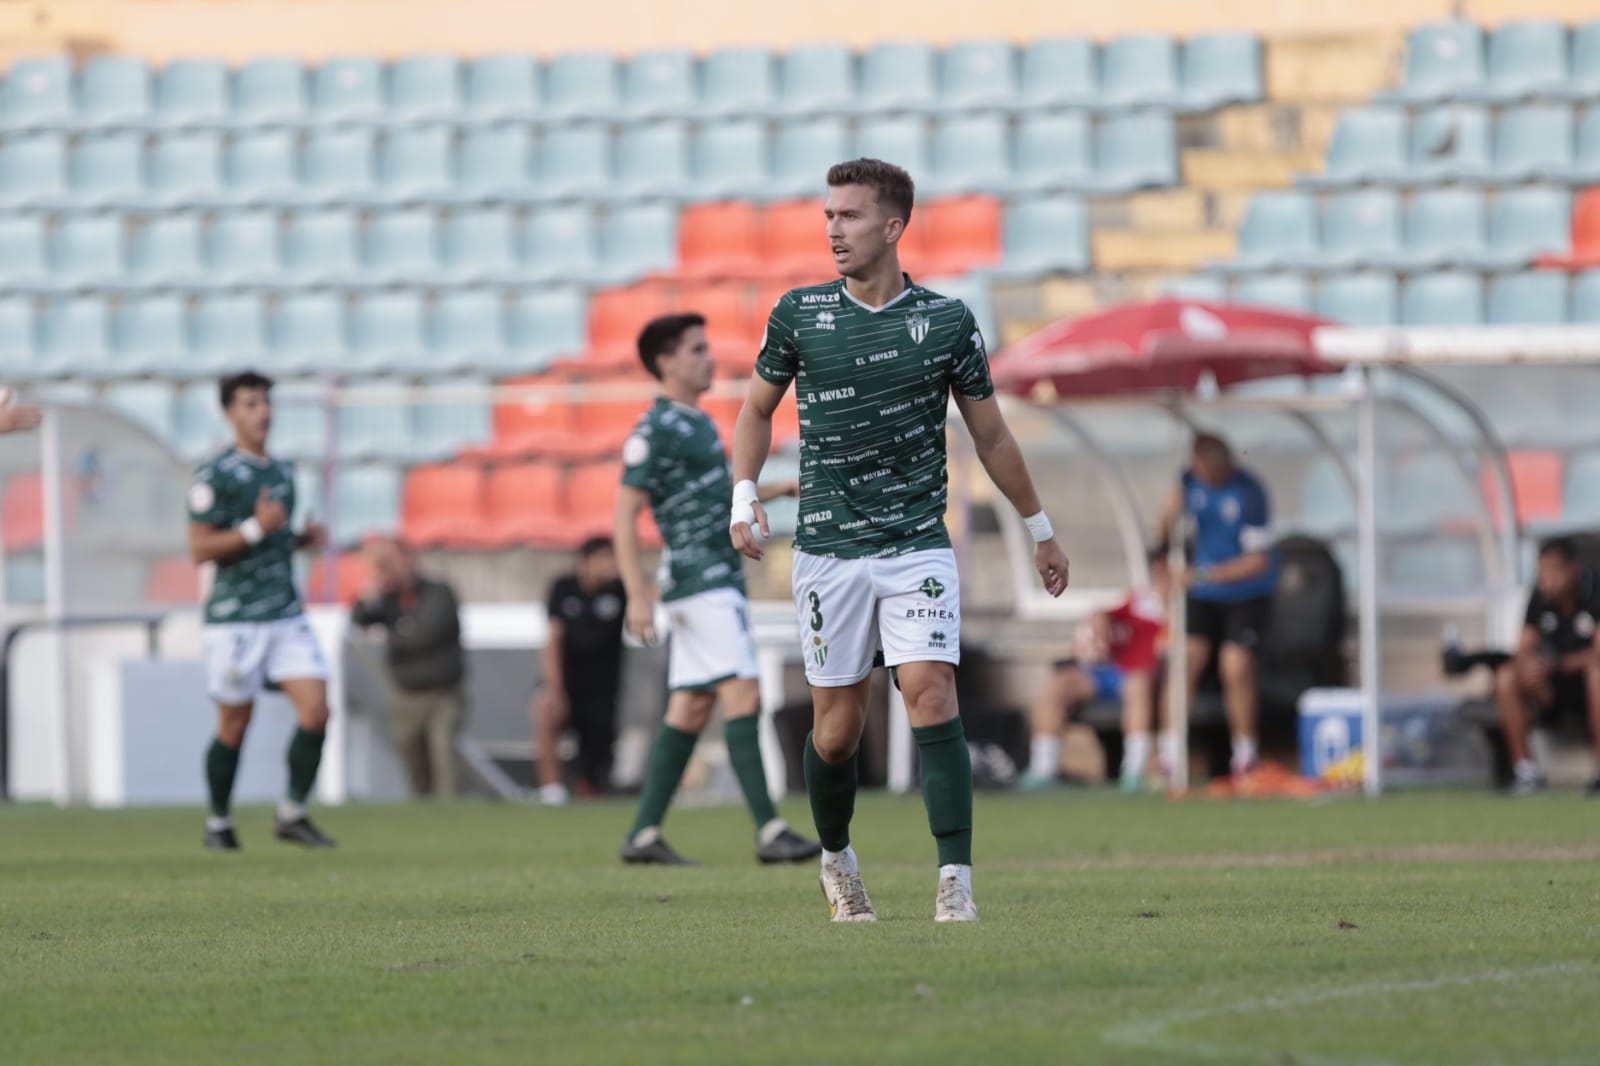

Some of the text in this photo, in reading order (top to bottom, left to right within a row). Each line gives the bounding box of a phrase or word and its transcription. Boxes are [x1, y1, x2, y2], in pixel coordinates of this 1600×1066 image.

[855, 357, 866, 366] EL
[807, 392, 817, 403] EL
[894, 435, 903, 443] EL
[849, 477, 860, 486] EL
[809, 591, 823, 632] 3
[906, 608, 955, 620] BEHER
